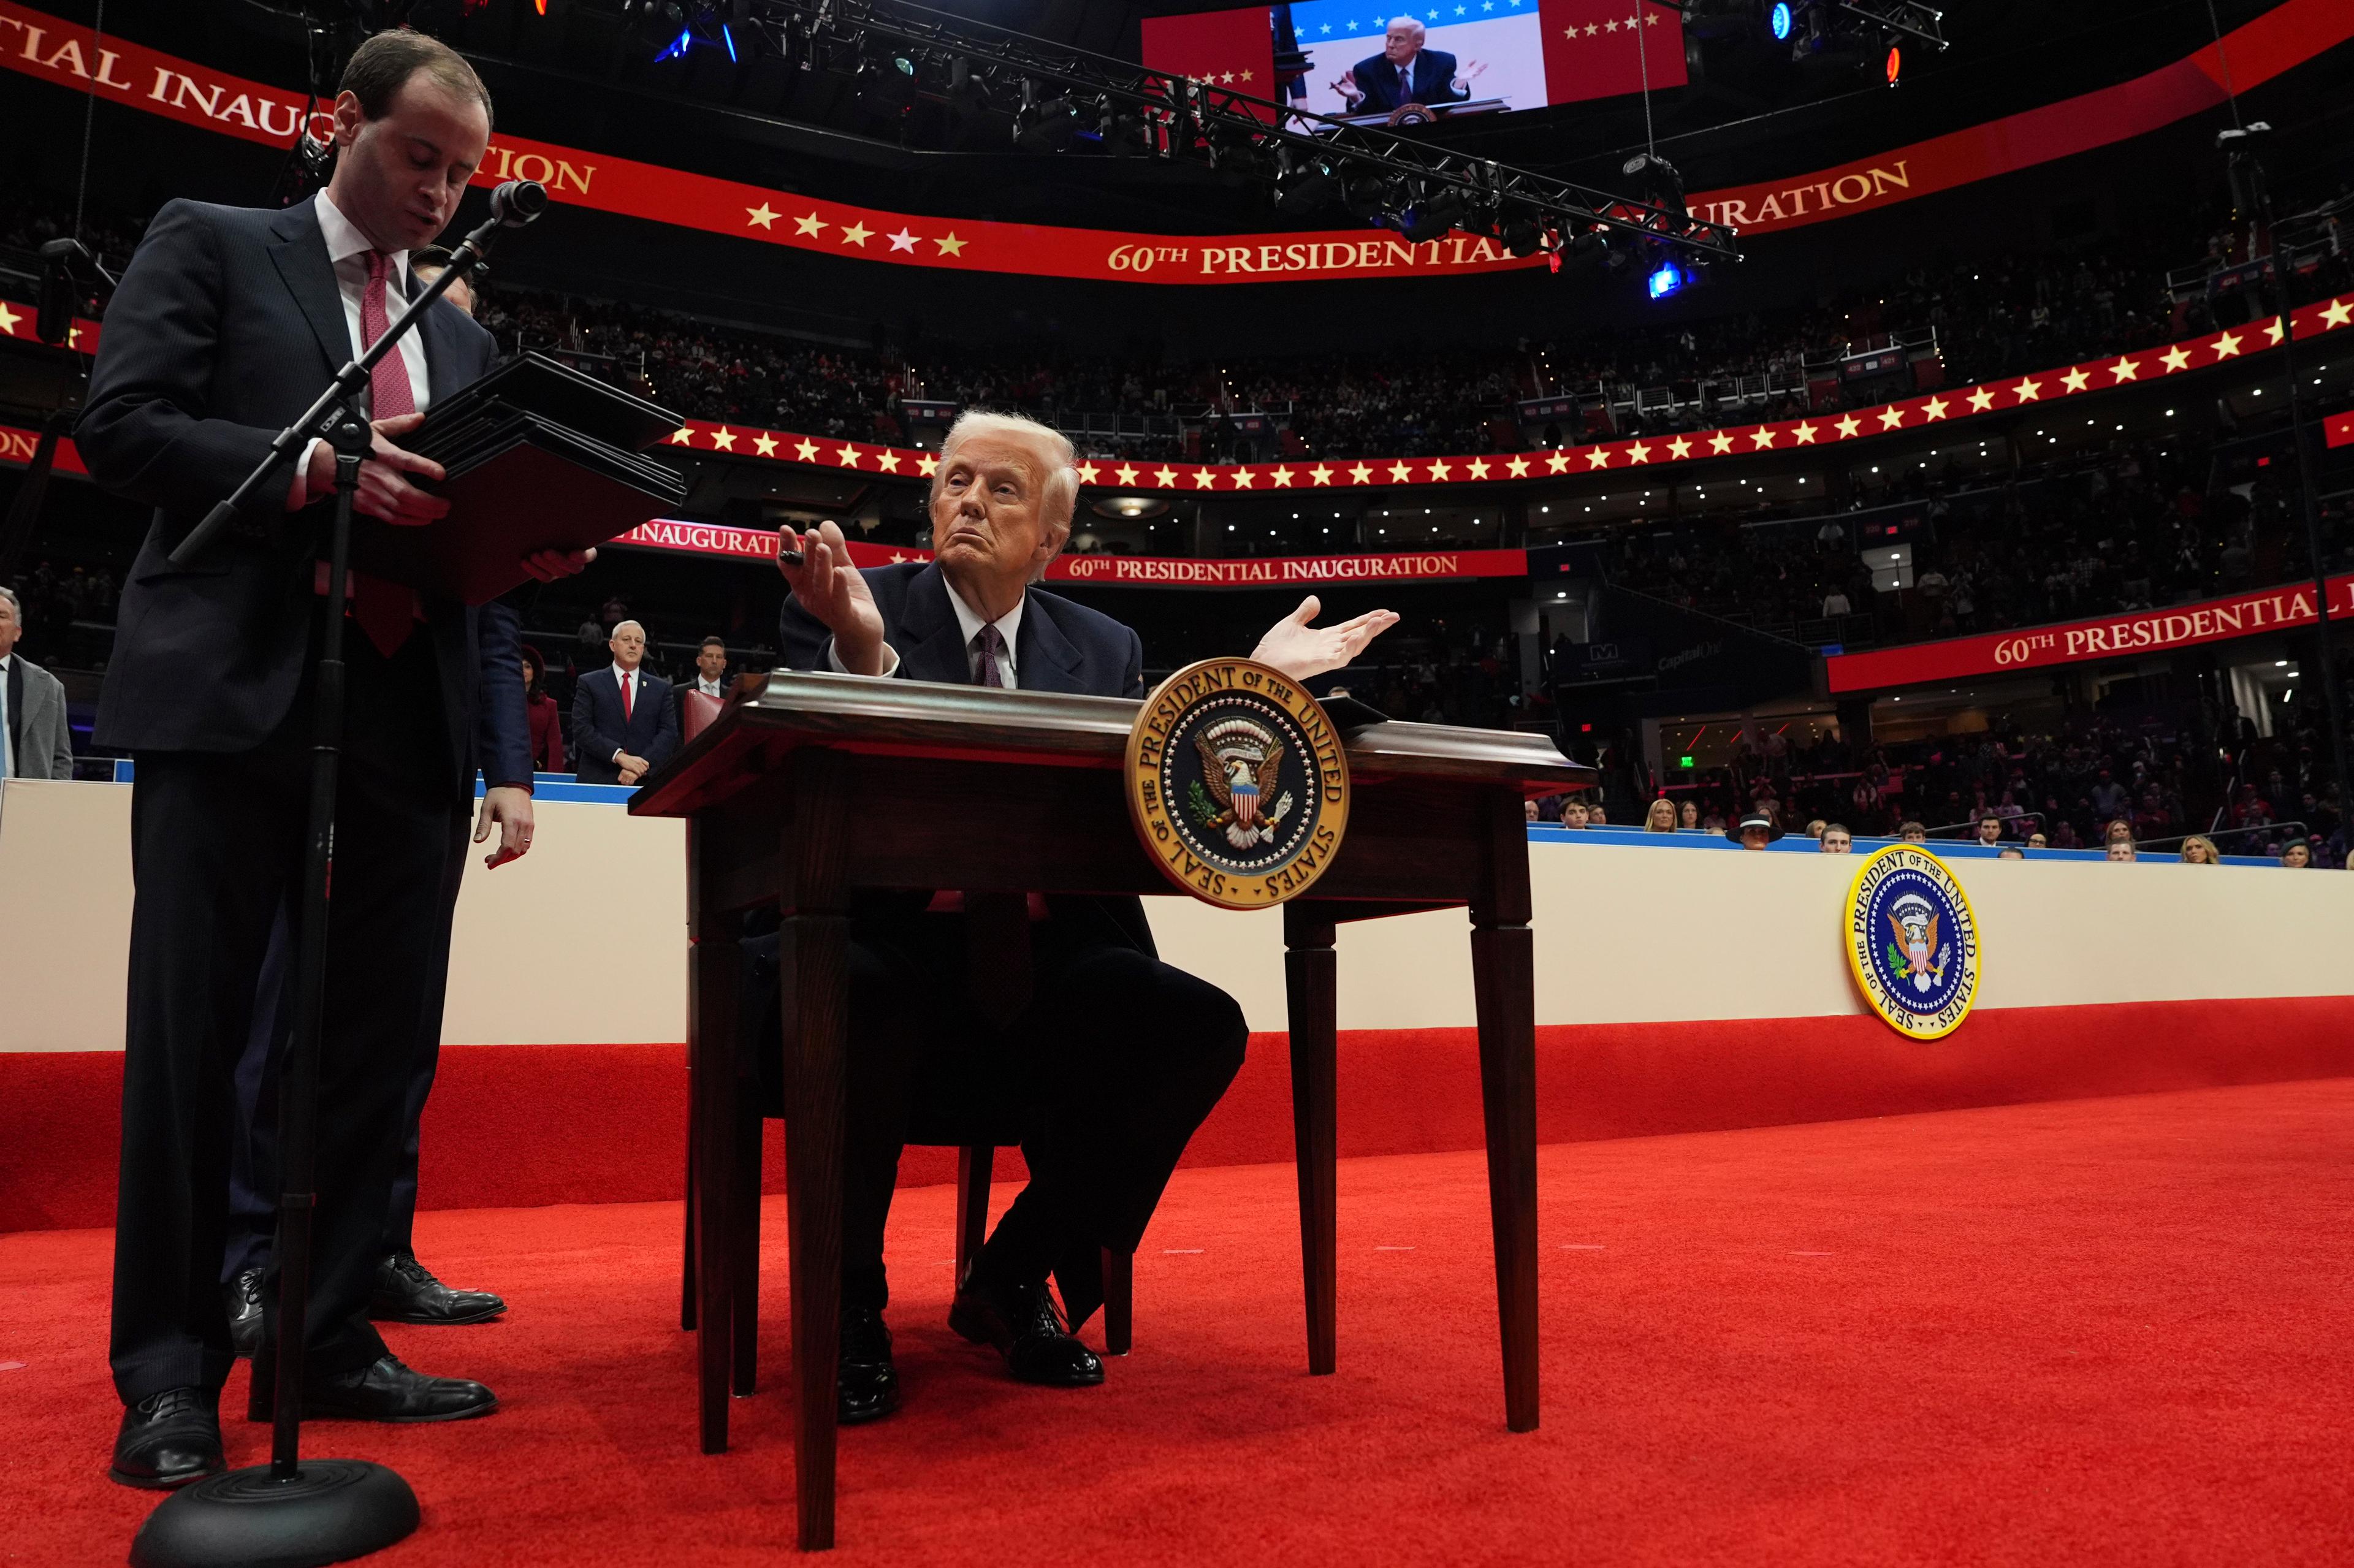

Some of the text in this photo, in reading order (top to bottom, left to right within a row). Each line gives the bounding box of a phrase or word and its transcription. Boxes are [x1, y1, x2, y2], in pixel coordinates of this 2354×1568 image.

[1108, 245, 1189, 272] 60TH
[631, 522, 805, 555] INAUGURAT
[1069, 555, 1457, 581] 60TH PRESIDENTIAL INAUGURATION
[1994, 634, 2054, 664] 60TH
[1139, 667, 1343, 897] SEAL OF THE PRESIDENT OF THE UNITED STATES
[1854, 851, 1976, 1029] SEAL OF THE PRESIDENT OF THE UNITED STATES
